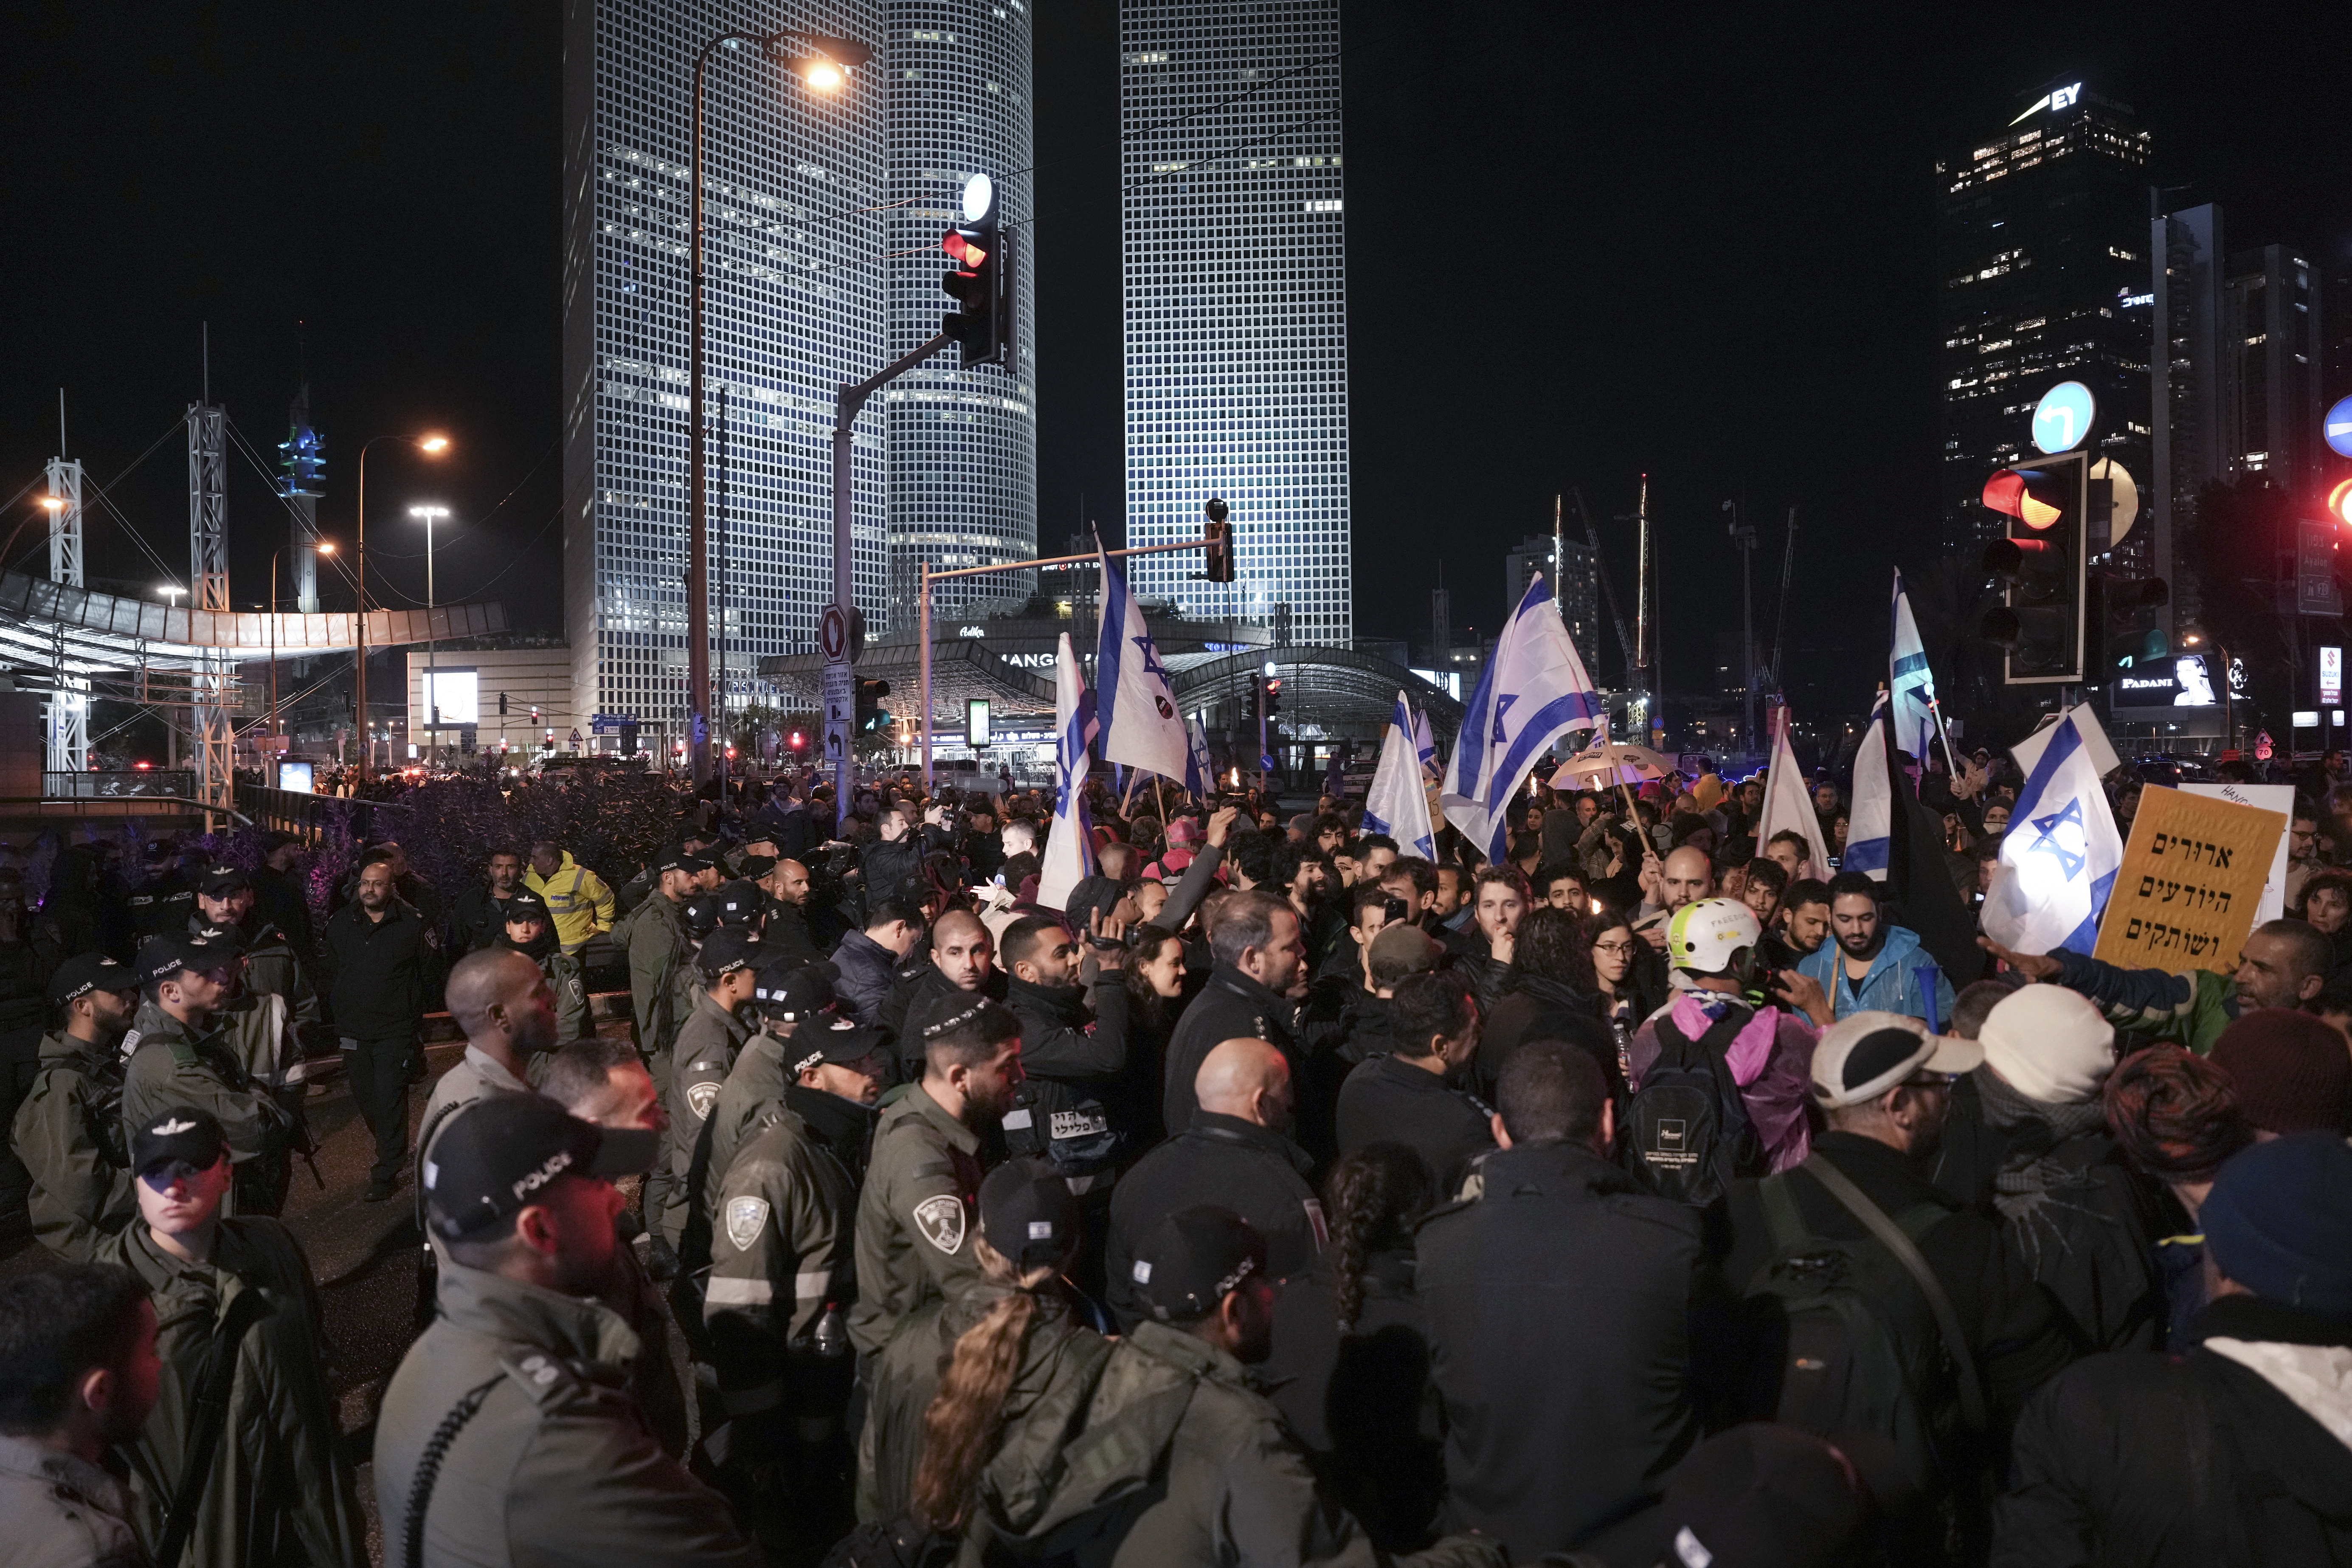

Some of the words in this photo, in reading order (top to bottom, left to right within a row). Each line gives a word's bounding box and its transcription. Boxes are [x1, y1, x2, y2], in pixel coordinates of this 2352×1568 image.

[2052, 82, 2082, 111] EY
[960, 625, 985, 638] Adika
[2122, 678, 2173, 689] PADANI
[661, 861, 678, 871] POLICE
[152, 958, 183, 978] POLICE
[719, 958, 745, 974] POLICE
[66, 981, 93, 1001] POLICE
[794, 1050, 824, 1073] POLICE
[1055, 1122, 1090, 1134] פלילי
[512, 1150, 573, 1201] POLICE
